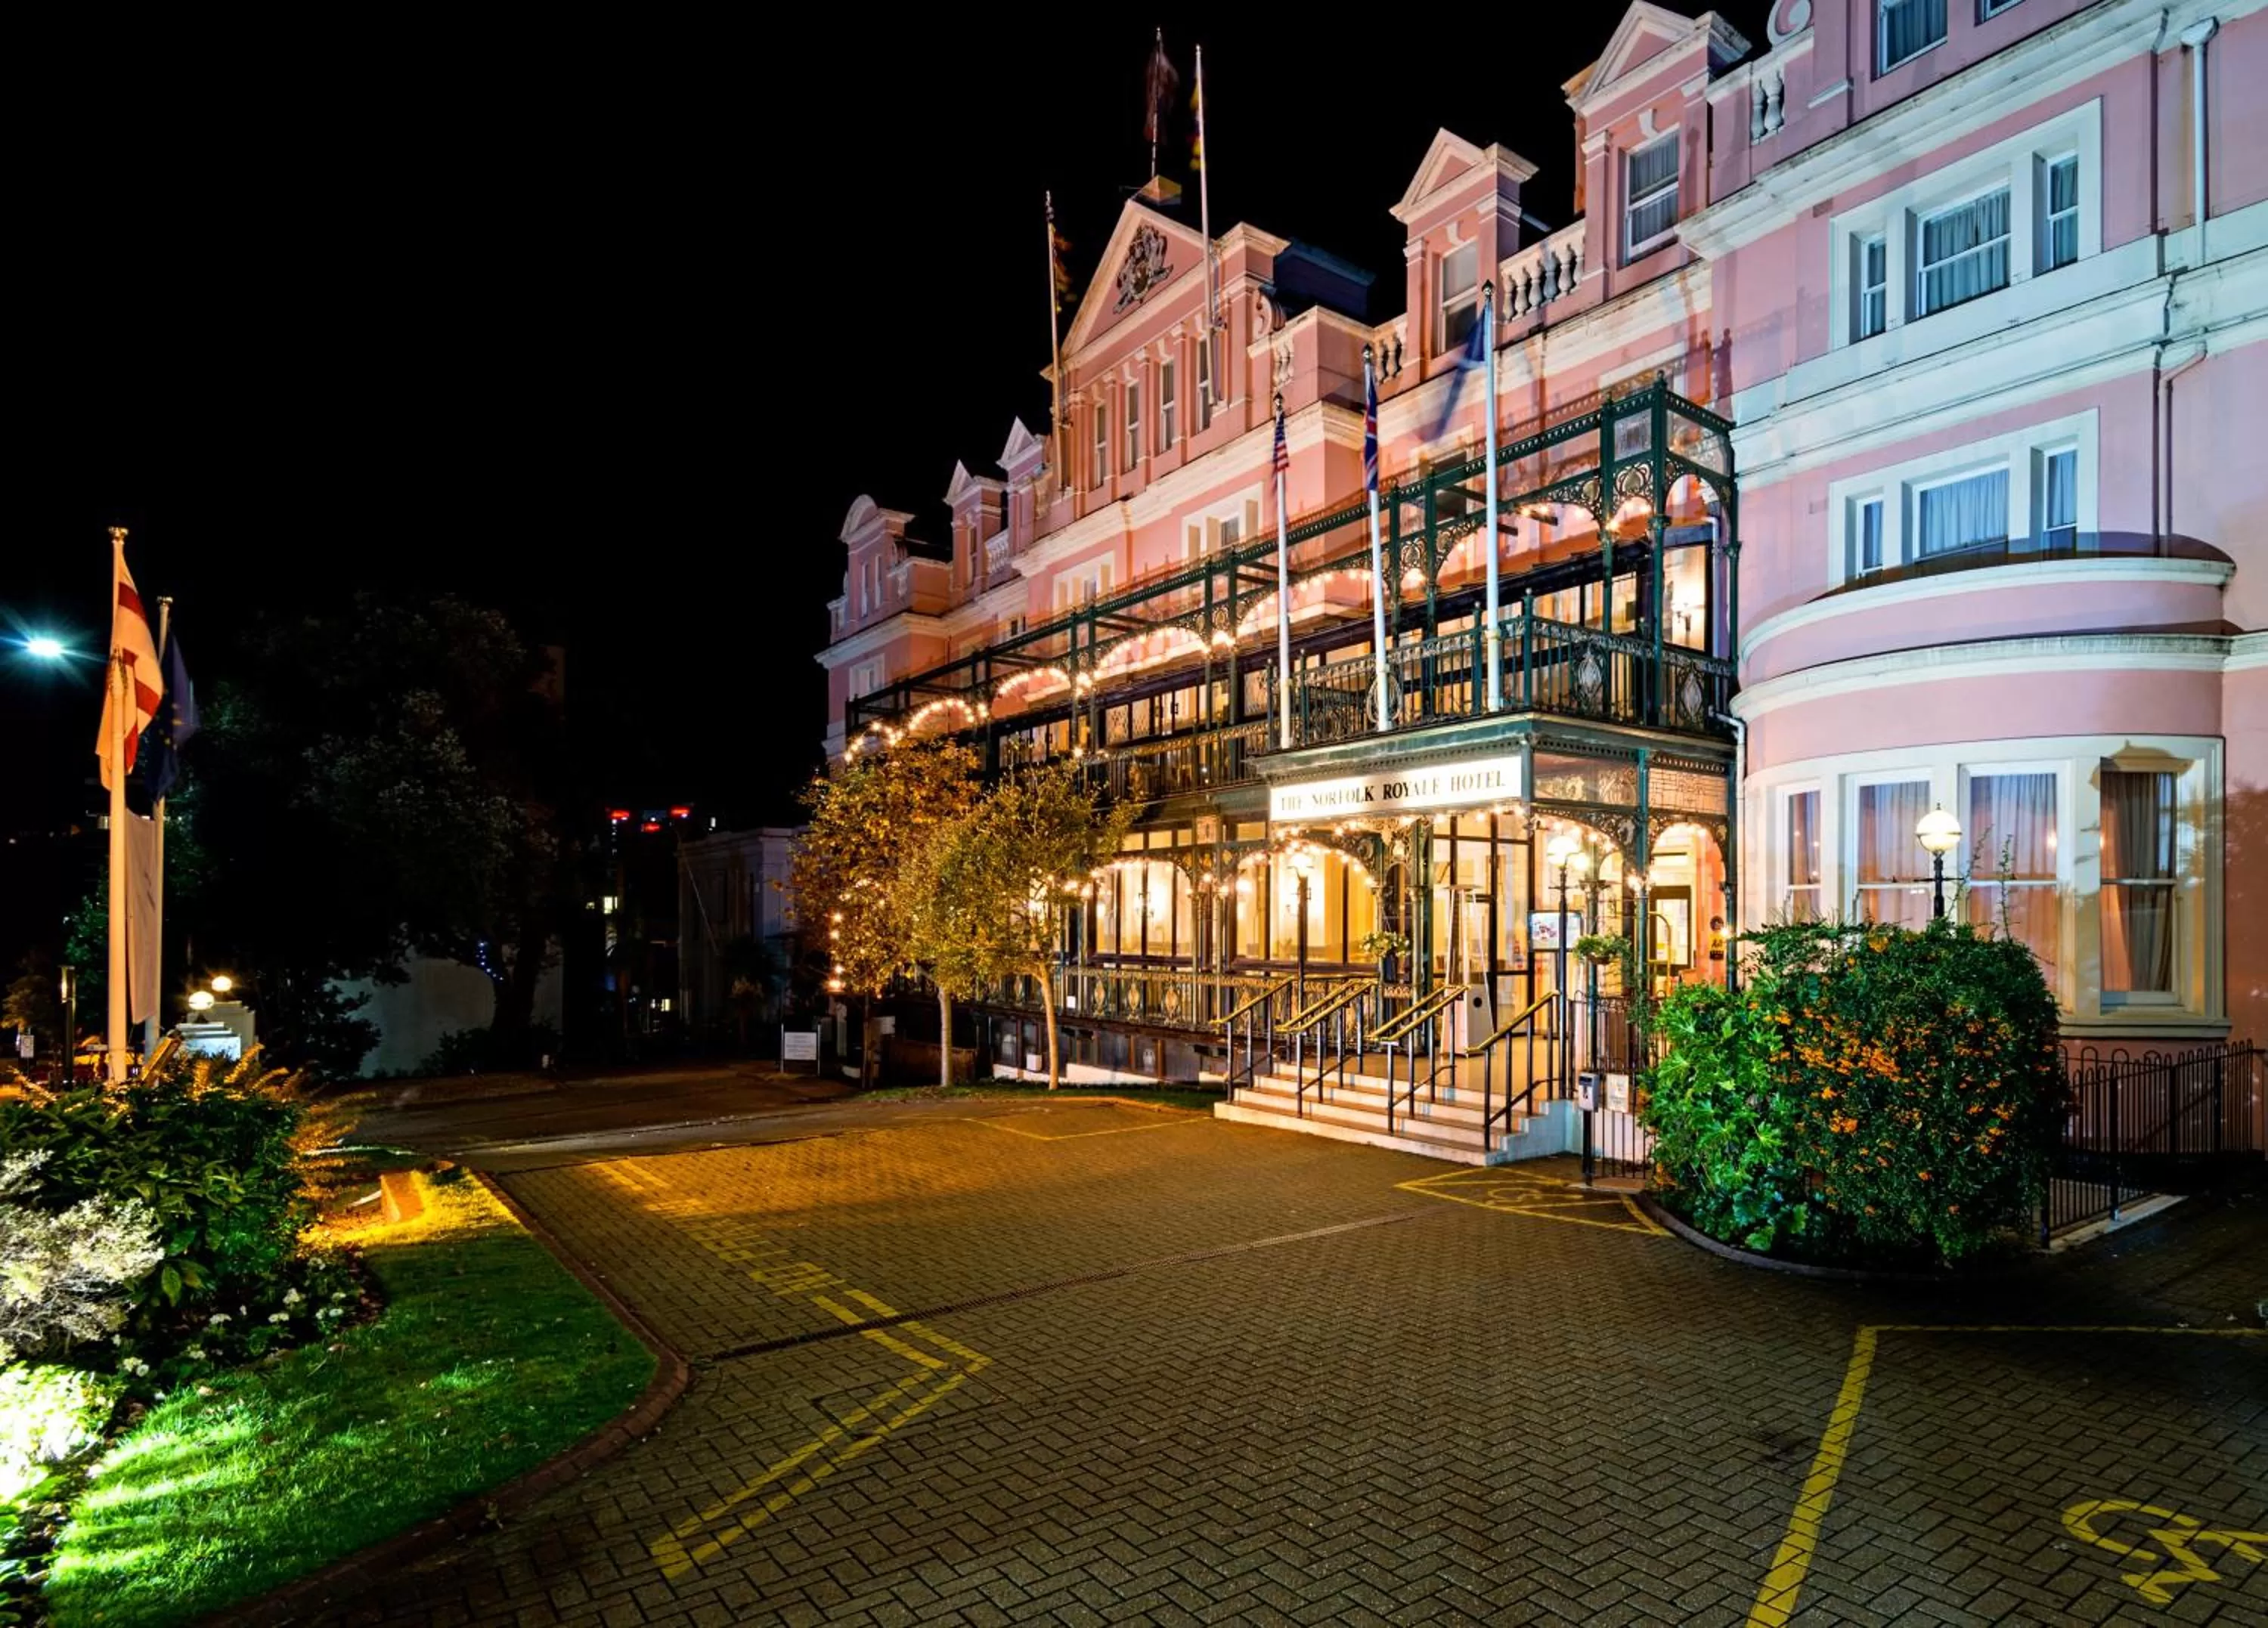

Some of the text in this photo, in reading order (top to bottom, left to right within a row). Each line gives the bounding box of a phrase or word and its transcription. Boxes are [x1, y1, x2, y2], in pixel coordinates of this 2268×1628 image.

[1312, 785, 1374, 808] NORFOLK
[1383, 777, 1440, 800] ROYALE
[1451, 770, 1507, 792] HOTEL
